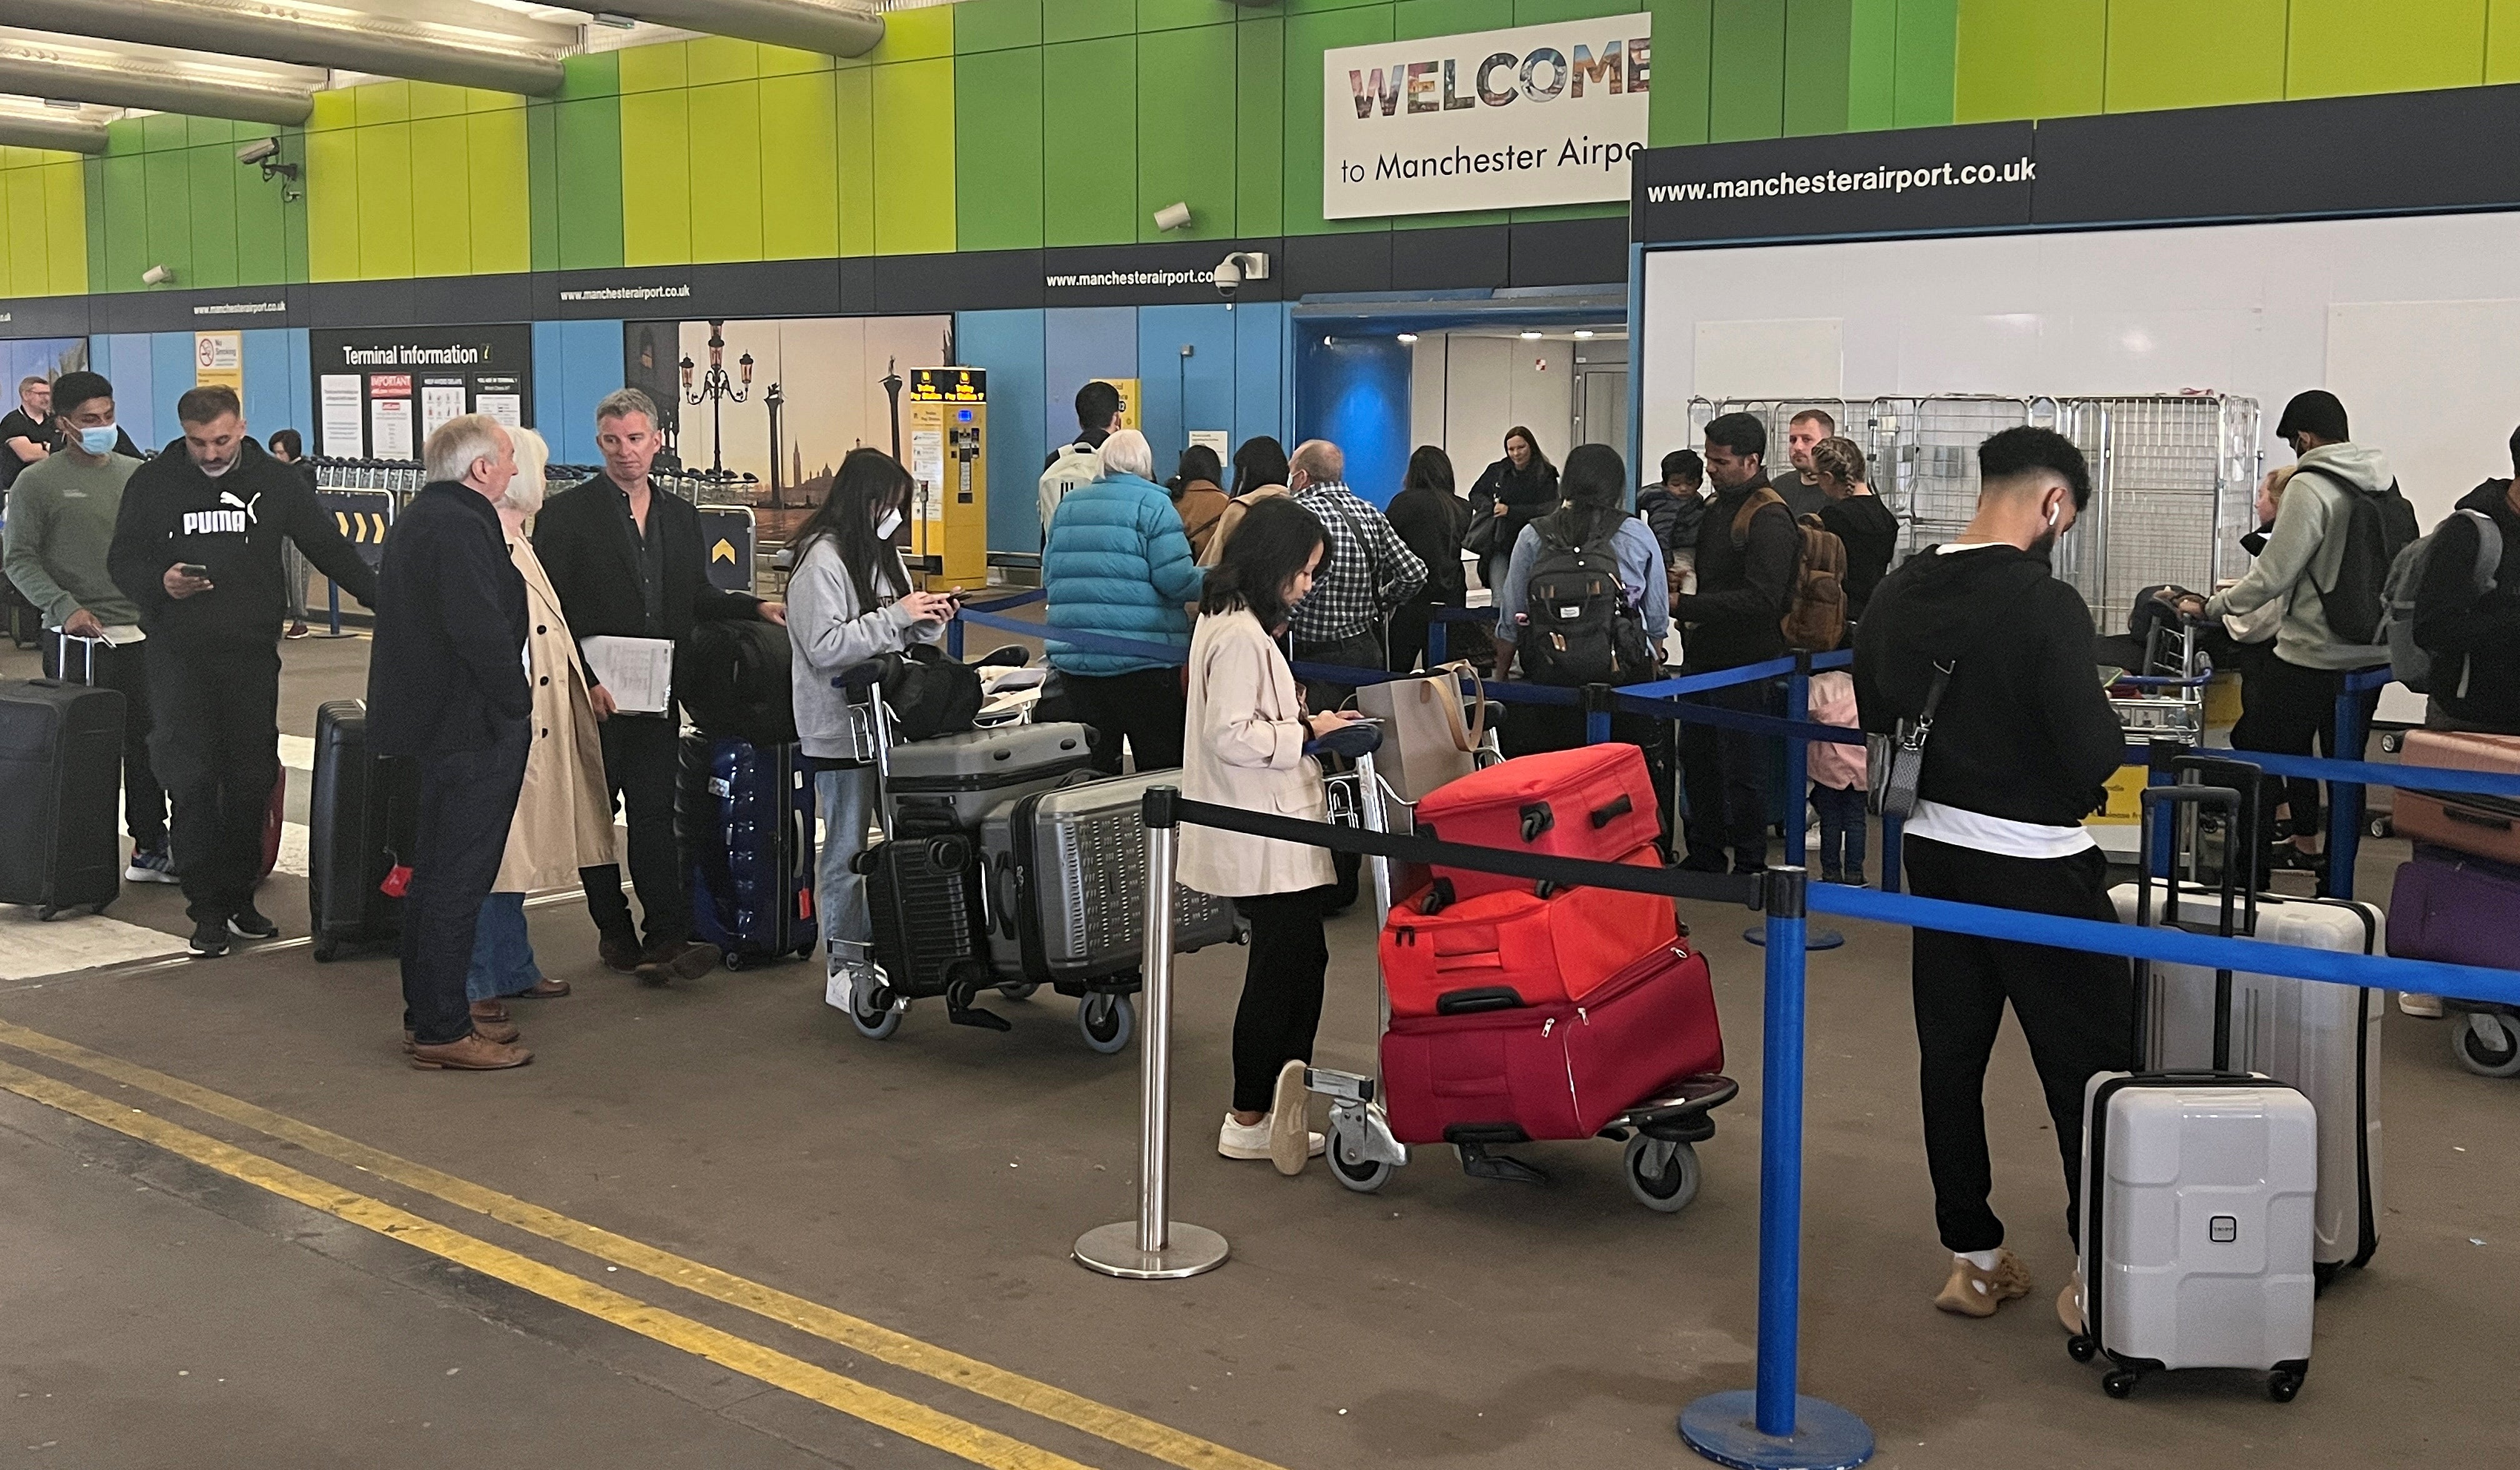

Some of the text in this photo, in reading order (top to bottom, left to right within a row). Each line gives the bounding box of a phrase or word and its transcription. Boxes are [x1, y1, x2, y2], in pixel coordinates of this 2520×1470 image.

[1349, 37, 1649, 119] WELCOME
[1341, 159, 1365, 183] to
[1375, 145, 1548, 181] Manchester
[1648, 157, 2036, 202] www.manchesterairport.co.uk
[560, 284, 690, 300] www.manchesterairport.co.uk
[342, 346, 398, 364] Terminal
[400, 344, 478, 364] information
[183, 510, 246, 535] PUMA
